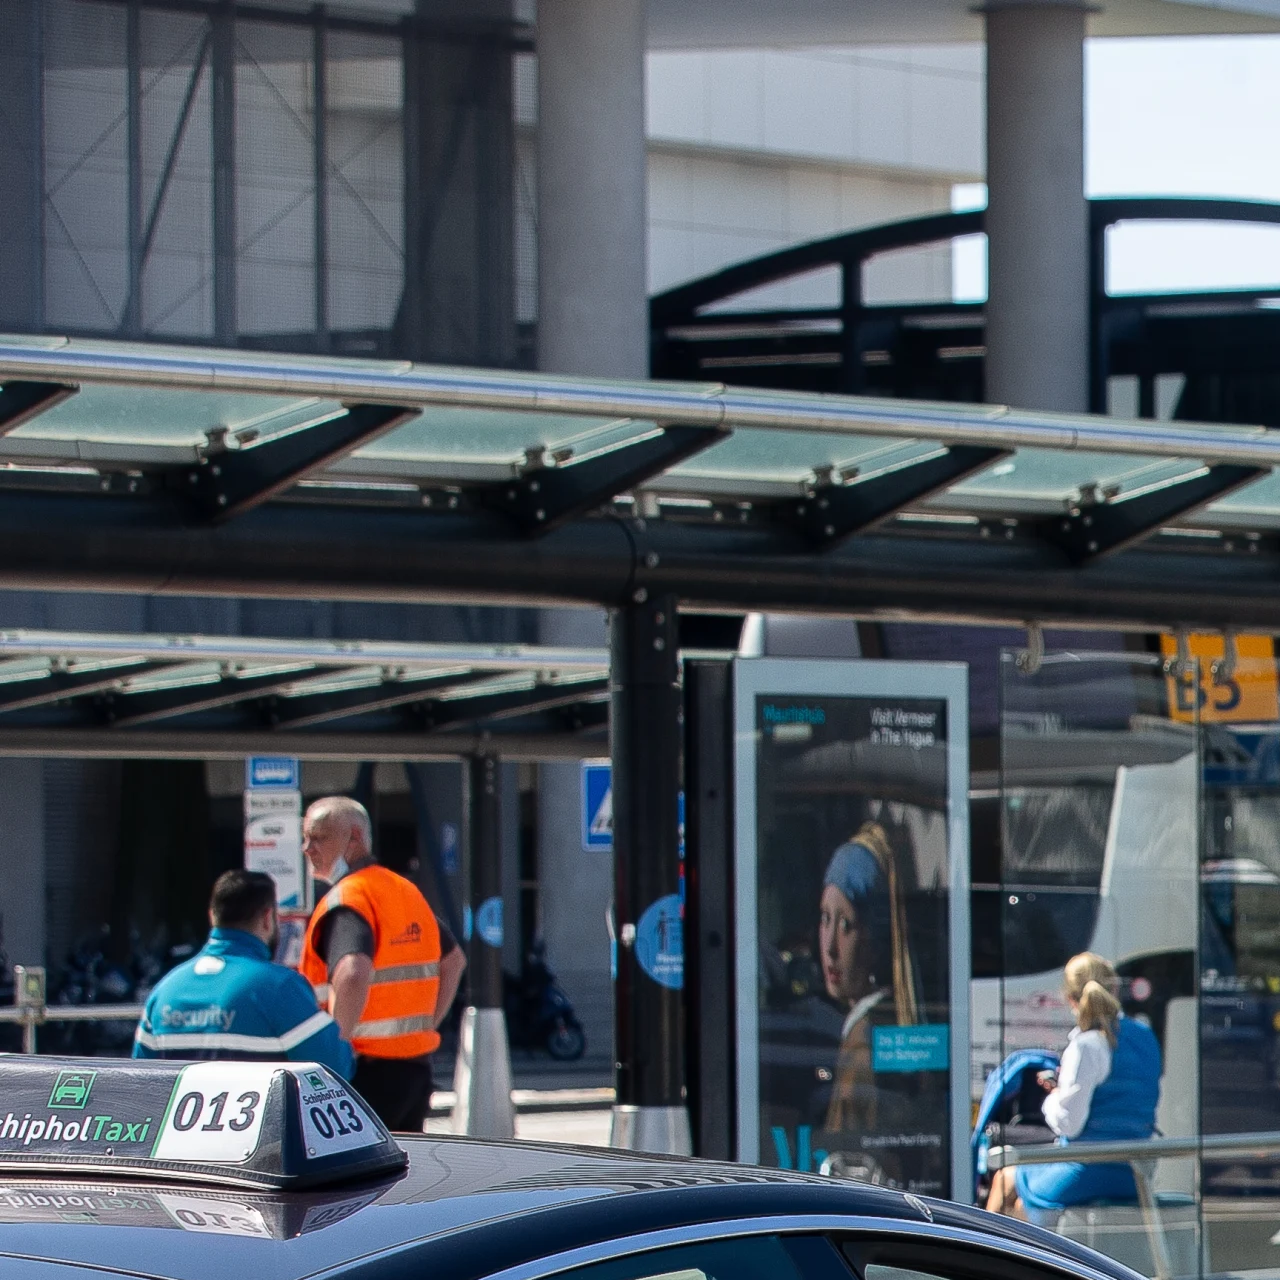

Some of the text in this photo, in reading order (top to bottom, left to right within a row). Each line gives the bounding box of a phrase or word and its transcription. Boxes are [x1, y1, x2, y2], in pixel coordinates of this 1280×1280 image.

[162, 1004, 236, 1032] Security
[172, 1091, 261, 1132] 013
[302, 1086, 347, 1105] SchipholTaxi
[310, 1100, 364, 1139] 013
